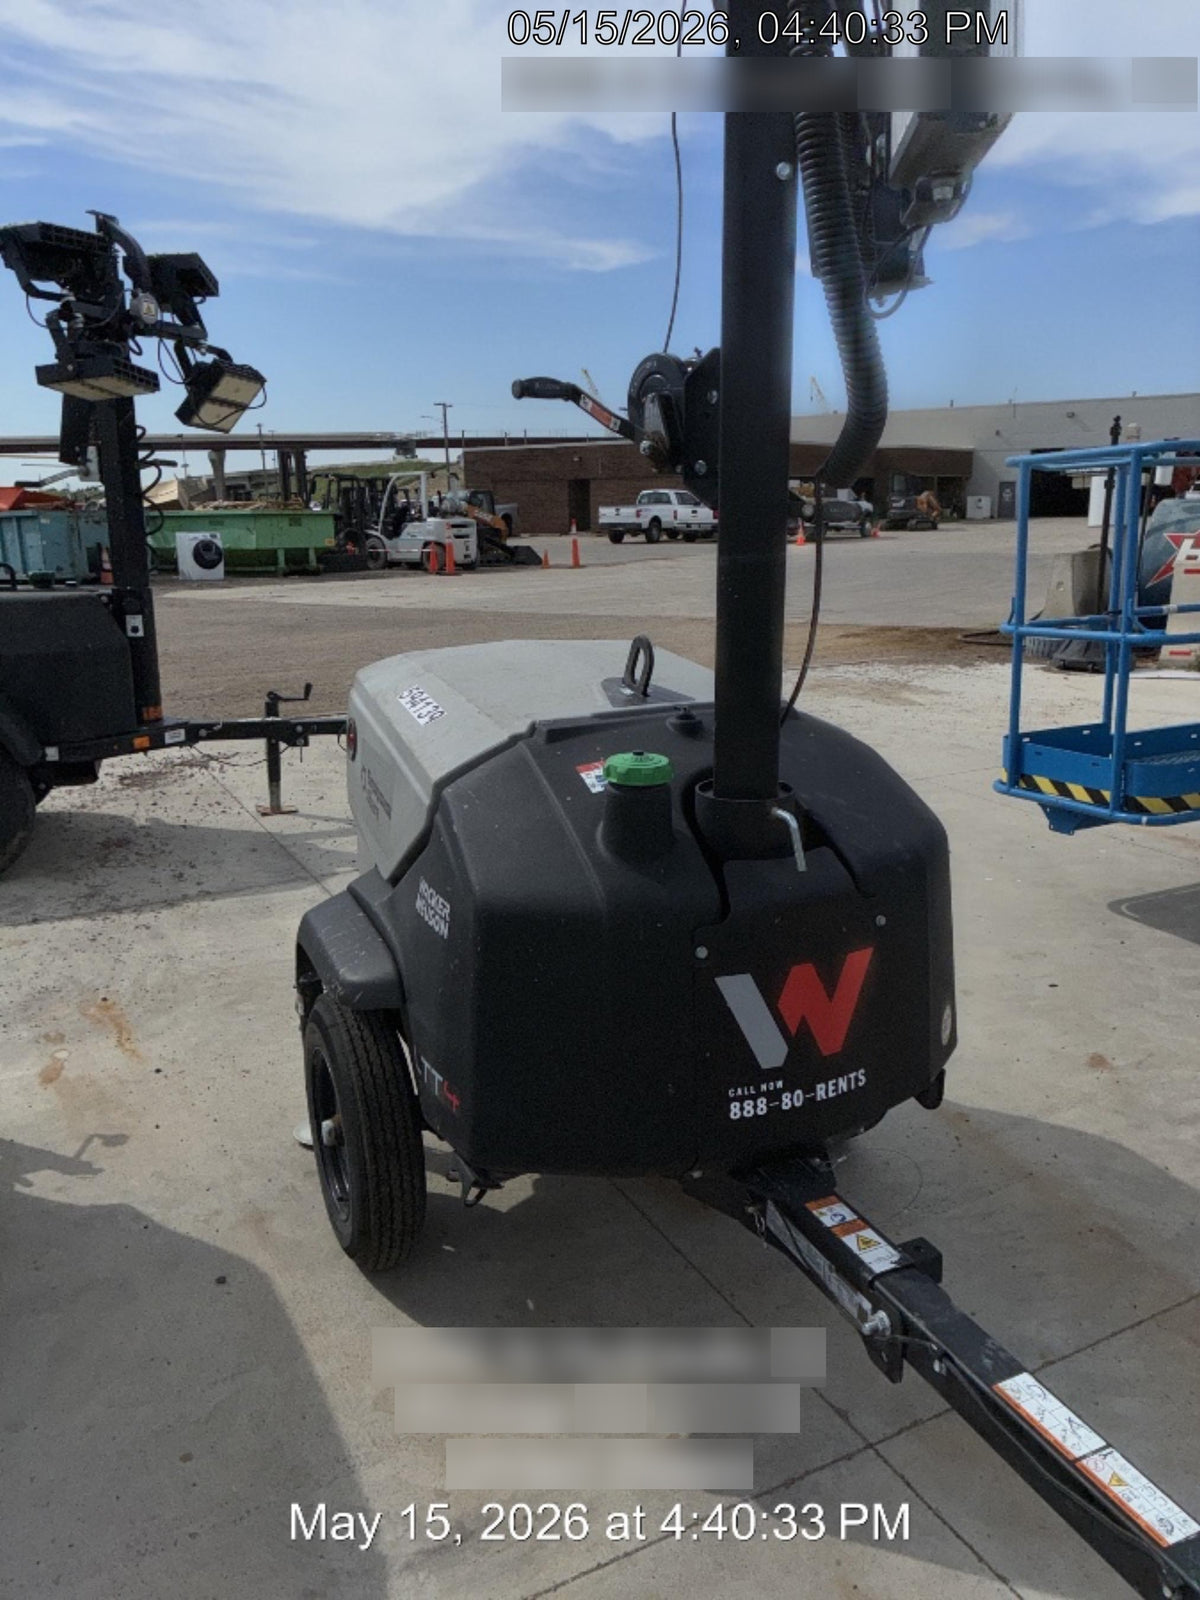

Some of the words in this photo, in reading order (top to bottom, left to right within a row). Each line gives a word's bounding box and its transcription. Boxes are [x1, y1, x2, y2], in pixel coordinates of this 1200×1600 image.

[728, 1086, 756, 1098] CALL
[760, 1080, 783, 1092] NOW
[729, 1068, 867, 1119] 888-80-RENTS
